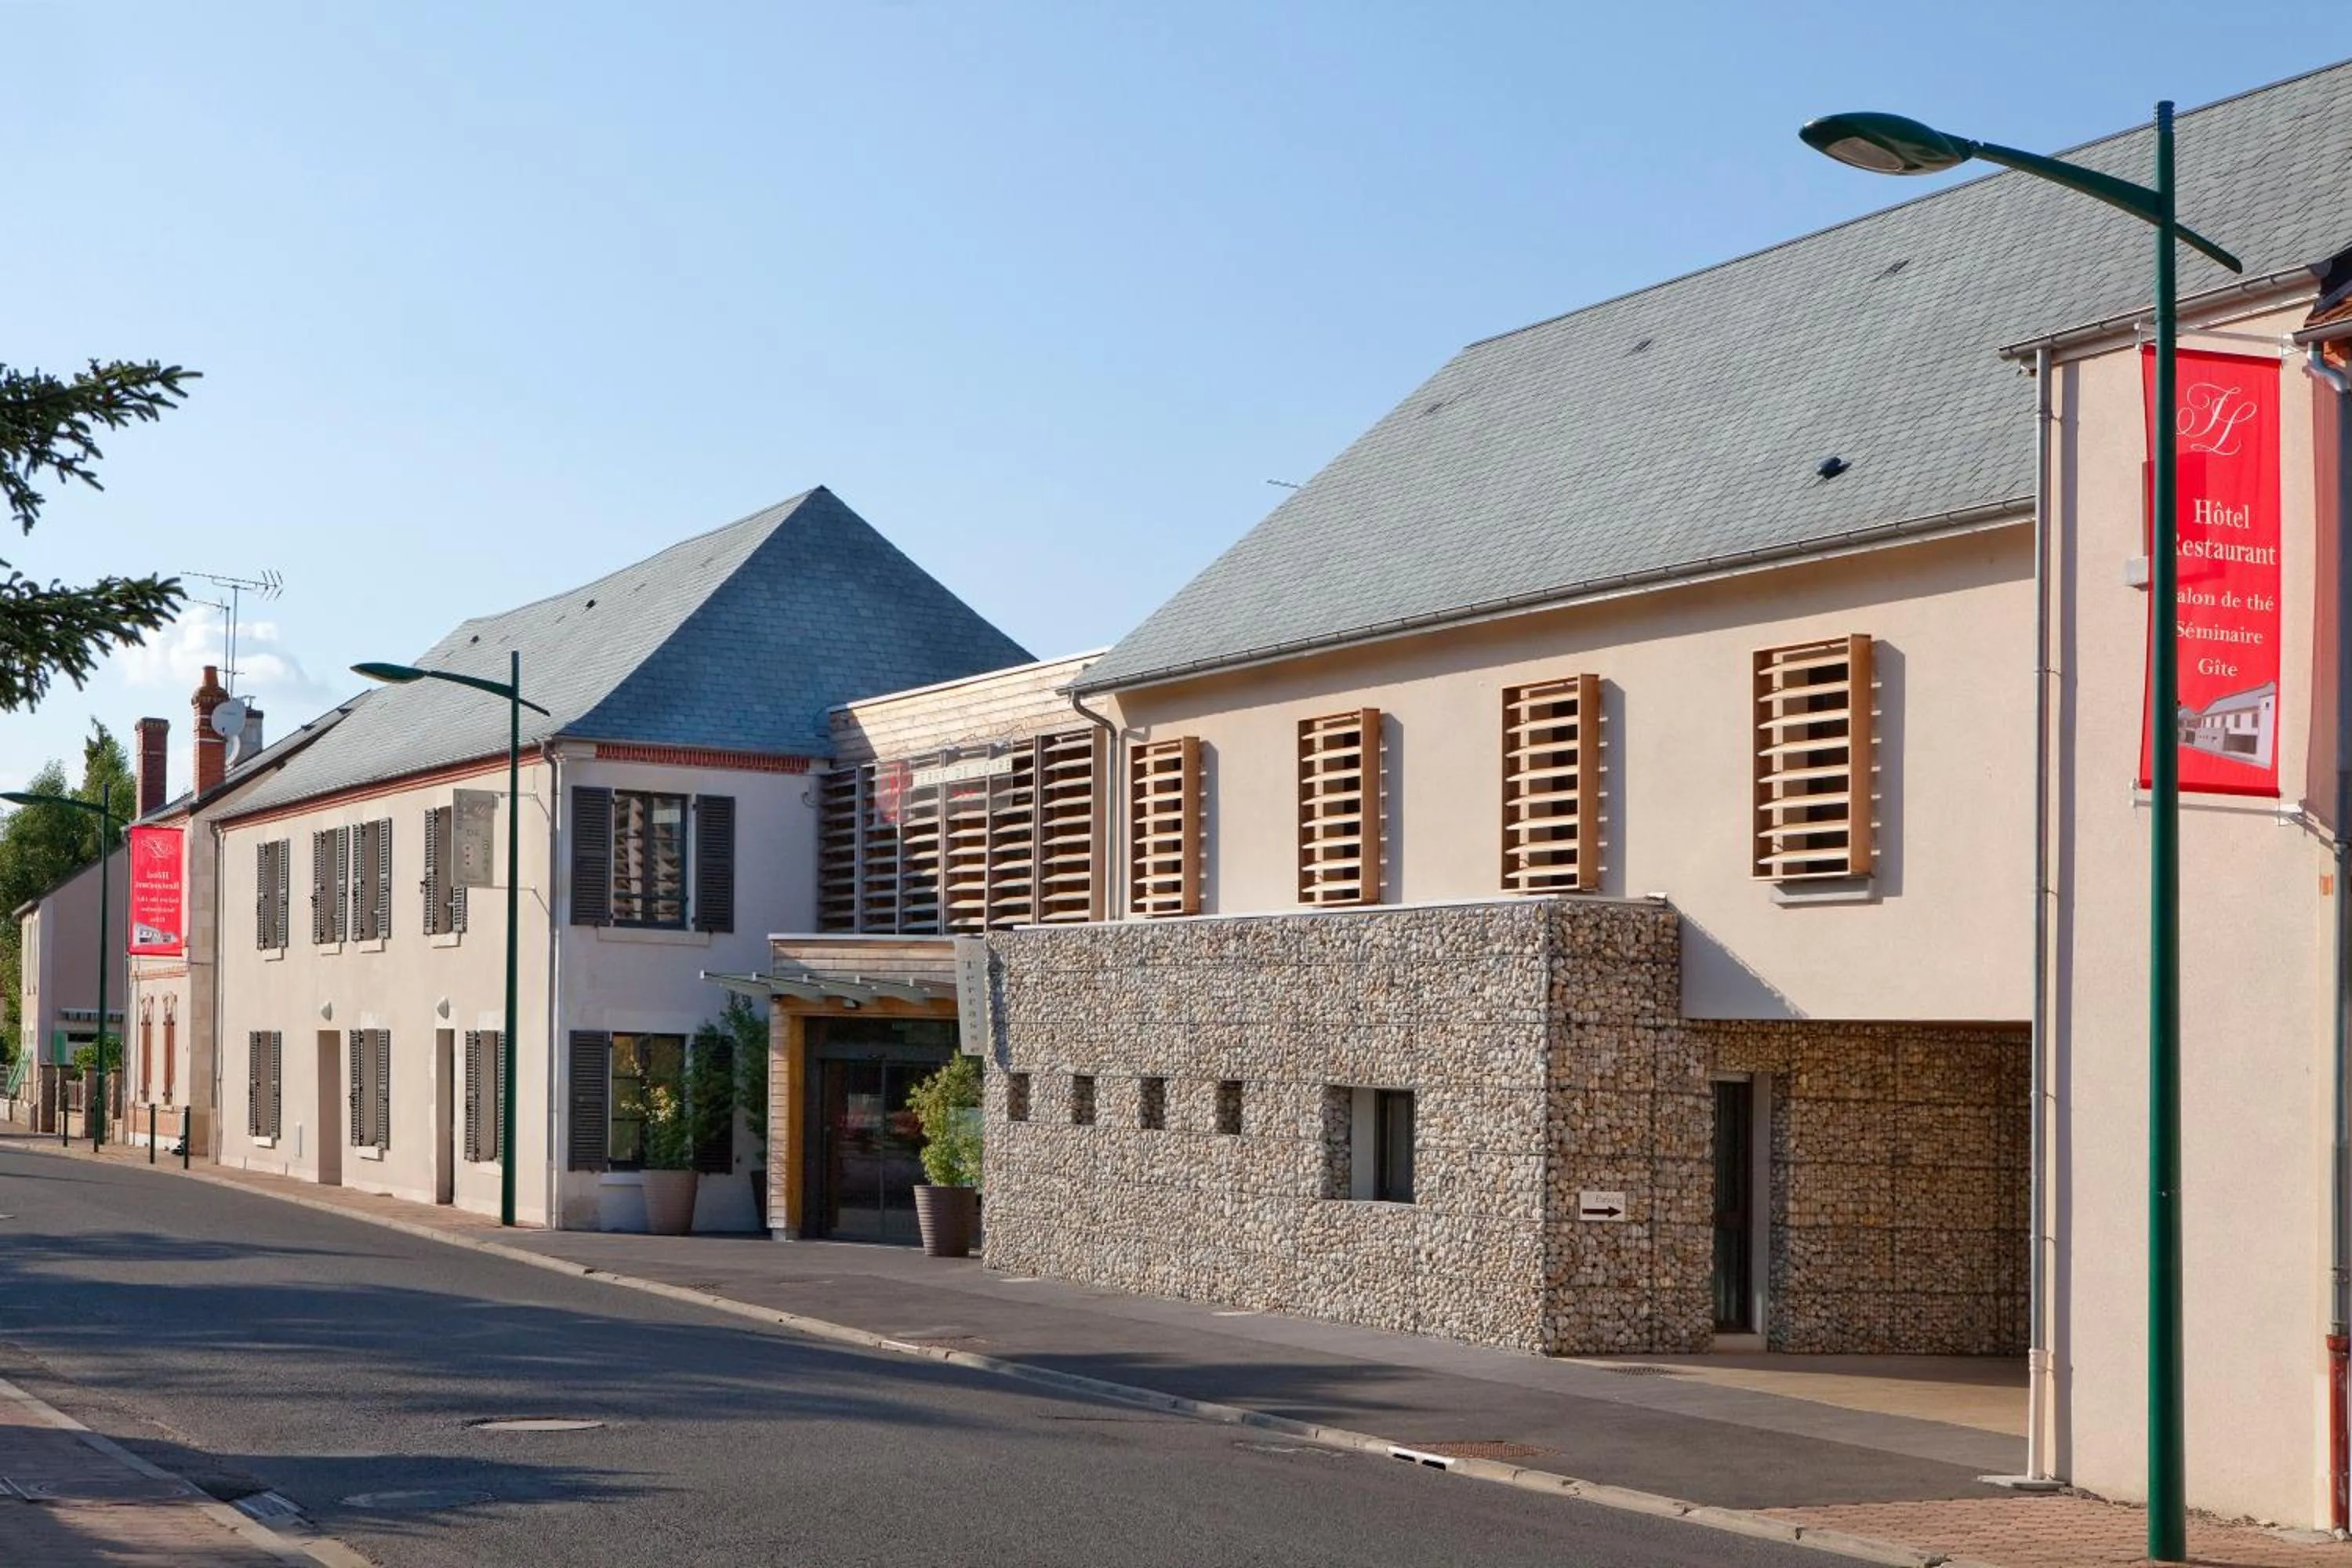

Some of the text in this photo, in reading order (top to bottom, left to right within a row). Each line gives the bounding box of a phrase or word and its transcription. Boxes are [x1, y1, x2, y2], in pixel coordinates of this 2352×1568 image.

[2194, 499, 2250, 529] Hôtel
[2177, 587, 2274, 612] alon de thé
[2176, 620, 2263, 644] Séminaire
[2198, 657, 2238, 677] Gîte
